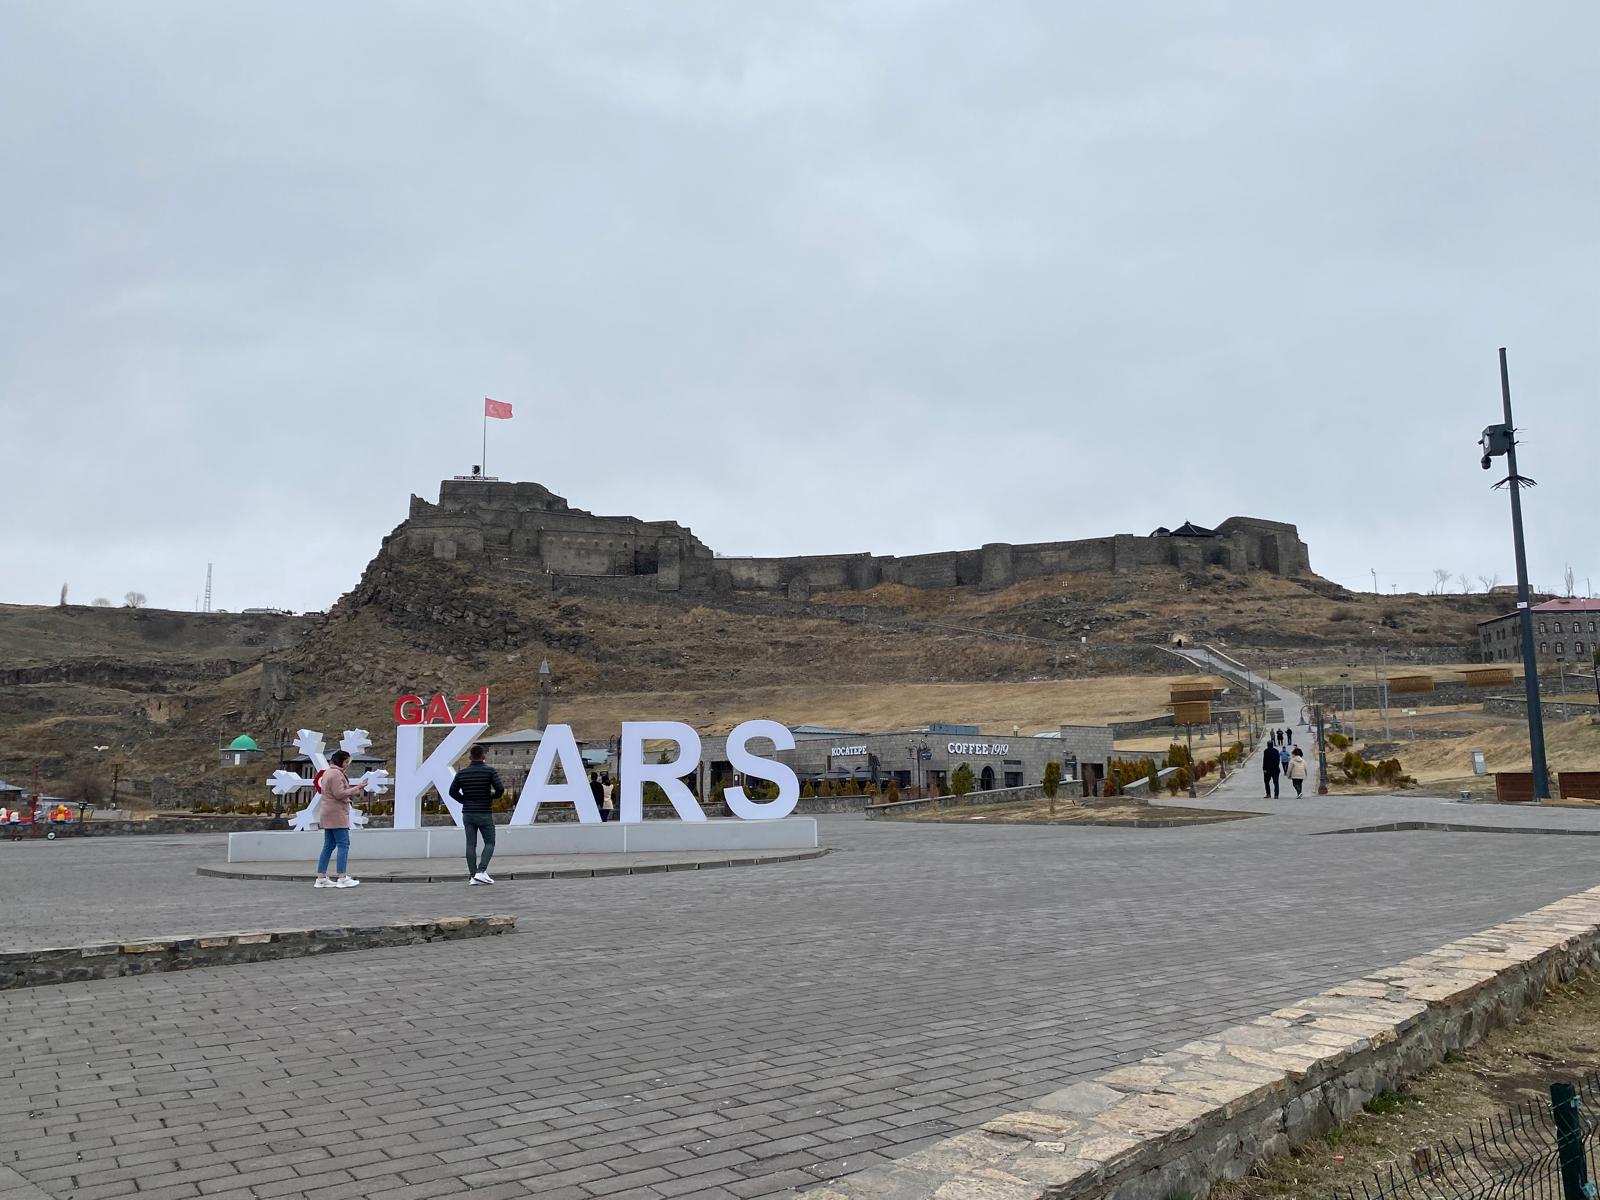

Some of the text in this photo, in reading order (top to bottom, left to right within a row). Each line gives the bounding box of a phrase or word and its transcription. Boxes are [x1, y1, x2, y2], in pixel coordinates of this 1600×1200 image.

[393, 687, 488, 724] GAZİ
[831, 745, 867, 757] KOCATEPE
[947, 742, 1009, 756] COFFEE 1919
[394, 719, 801, 829] KARS
